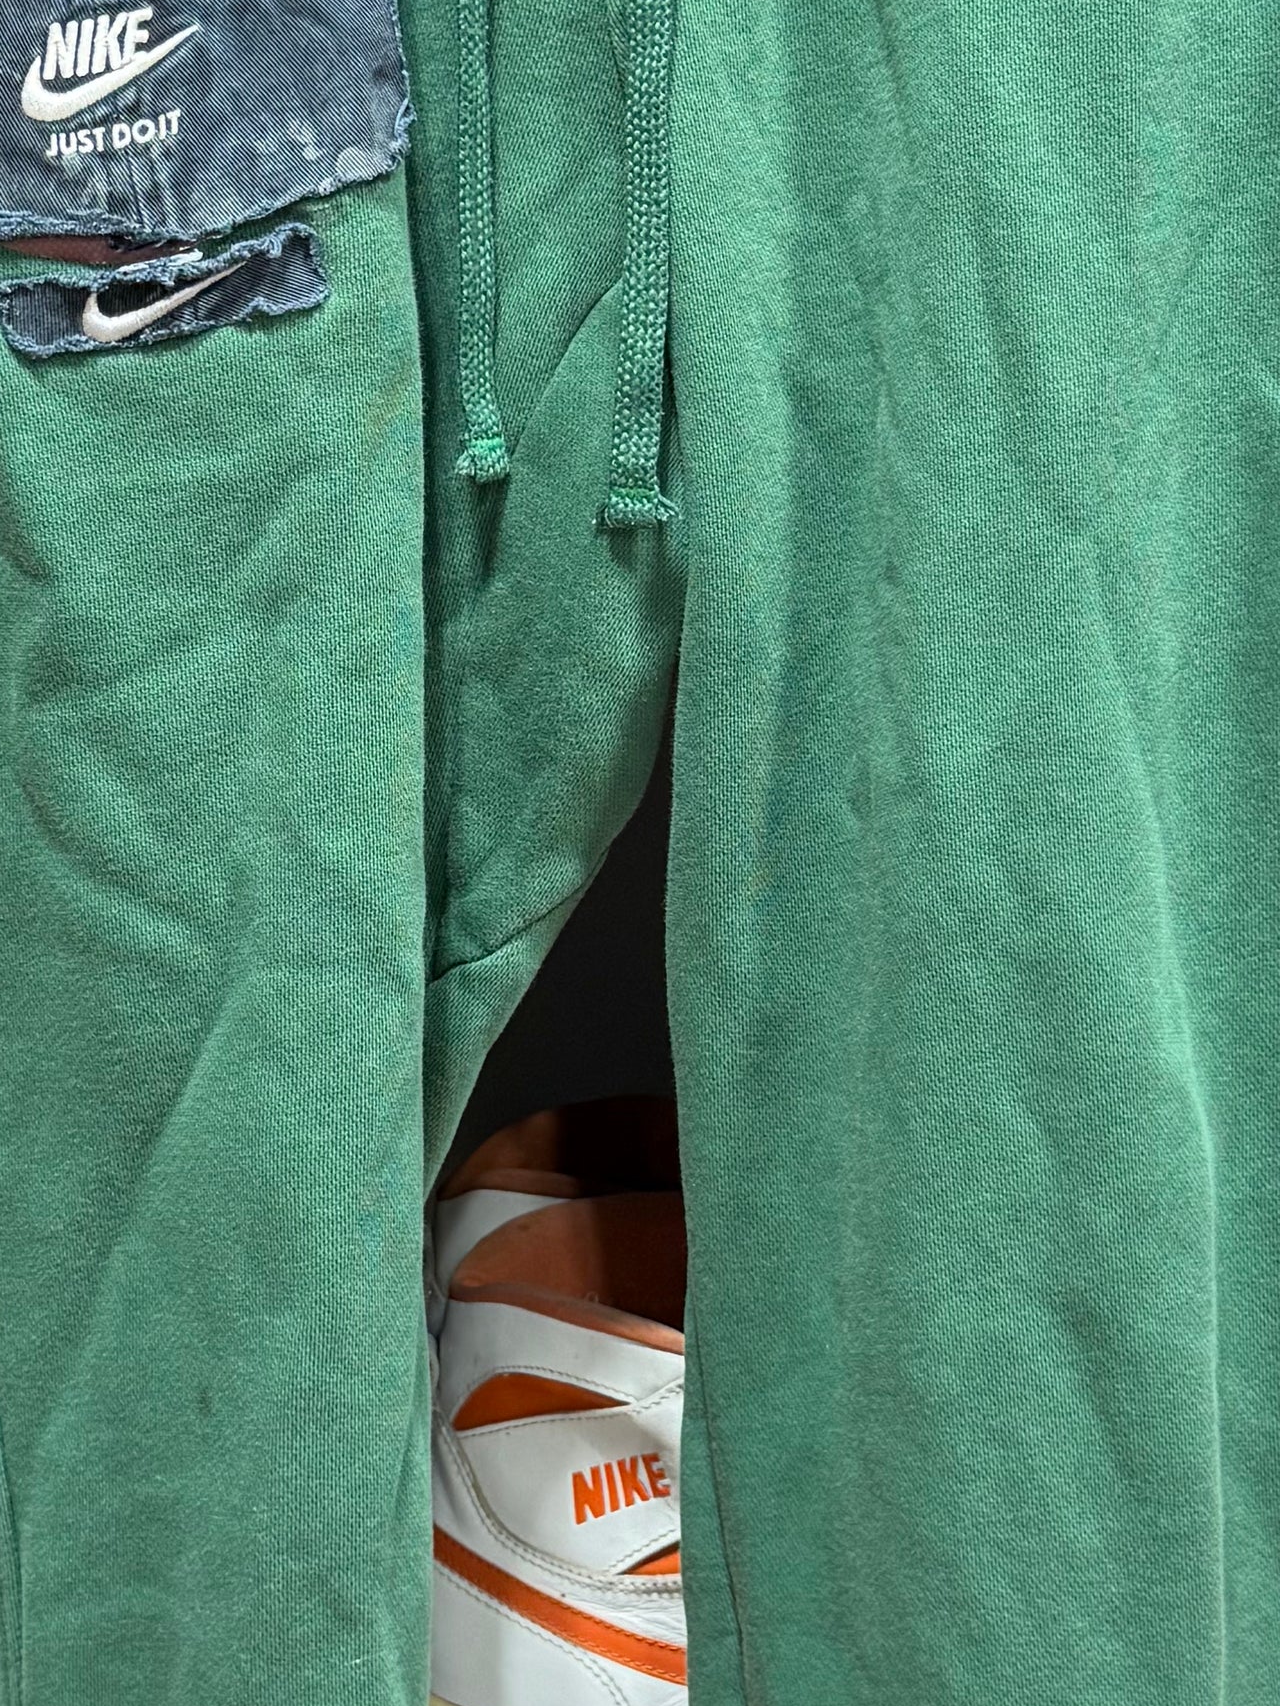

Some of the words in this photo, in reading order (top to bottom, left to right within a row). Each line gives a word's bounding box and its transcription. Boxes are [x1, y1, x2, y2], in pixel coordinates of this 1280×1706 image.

[43, 6, 154, 80] NIKE
[45, 126, 106, 158] JUST
[112, 118, 156, 150] DO
[158, 107, 182, 141] IT
[572, 1452, 671, 1525] NIKE
